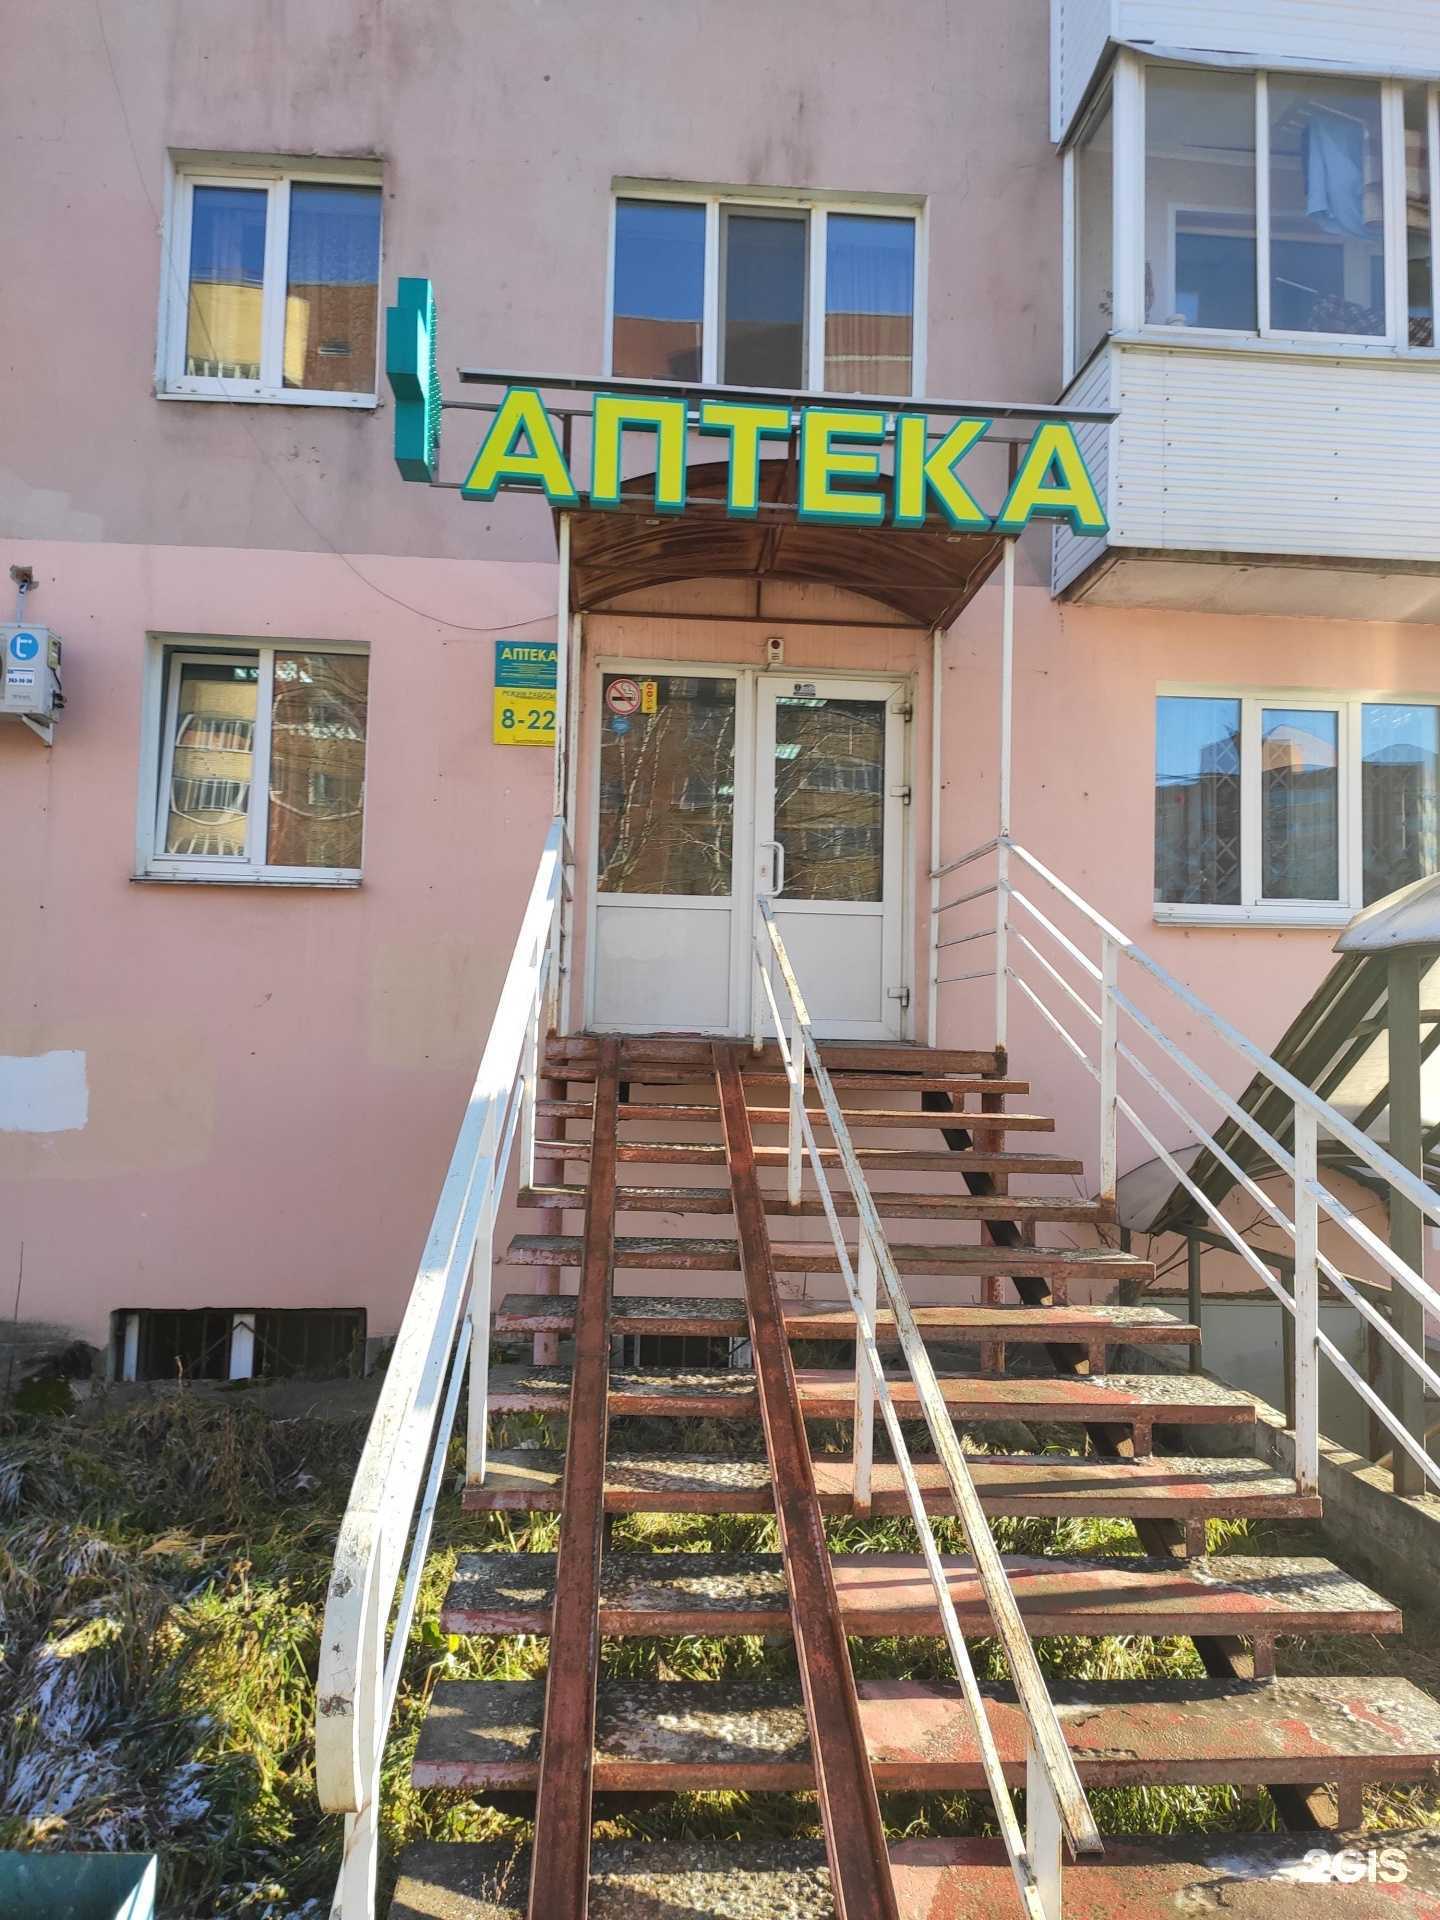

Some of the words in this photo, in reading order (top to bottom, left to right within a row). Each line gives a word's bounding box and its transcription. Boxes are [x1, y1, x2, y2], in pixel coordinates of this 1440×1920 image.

[461, 385, 1110, 537] АПТЕКА
[501, 647, 558, 662] АПТЕКА
[502, 708, 556, 730] 8-22
